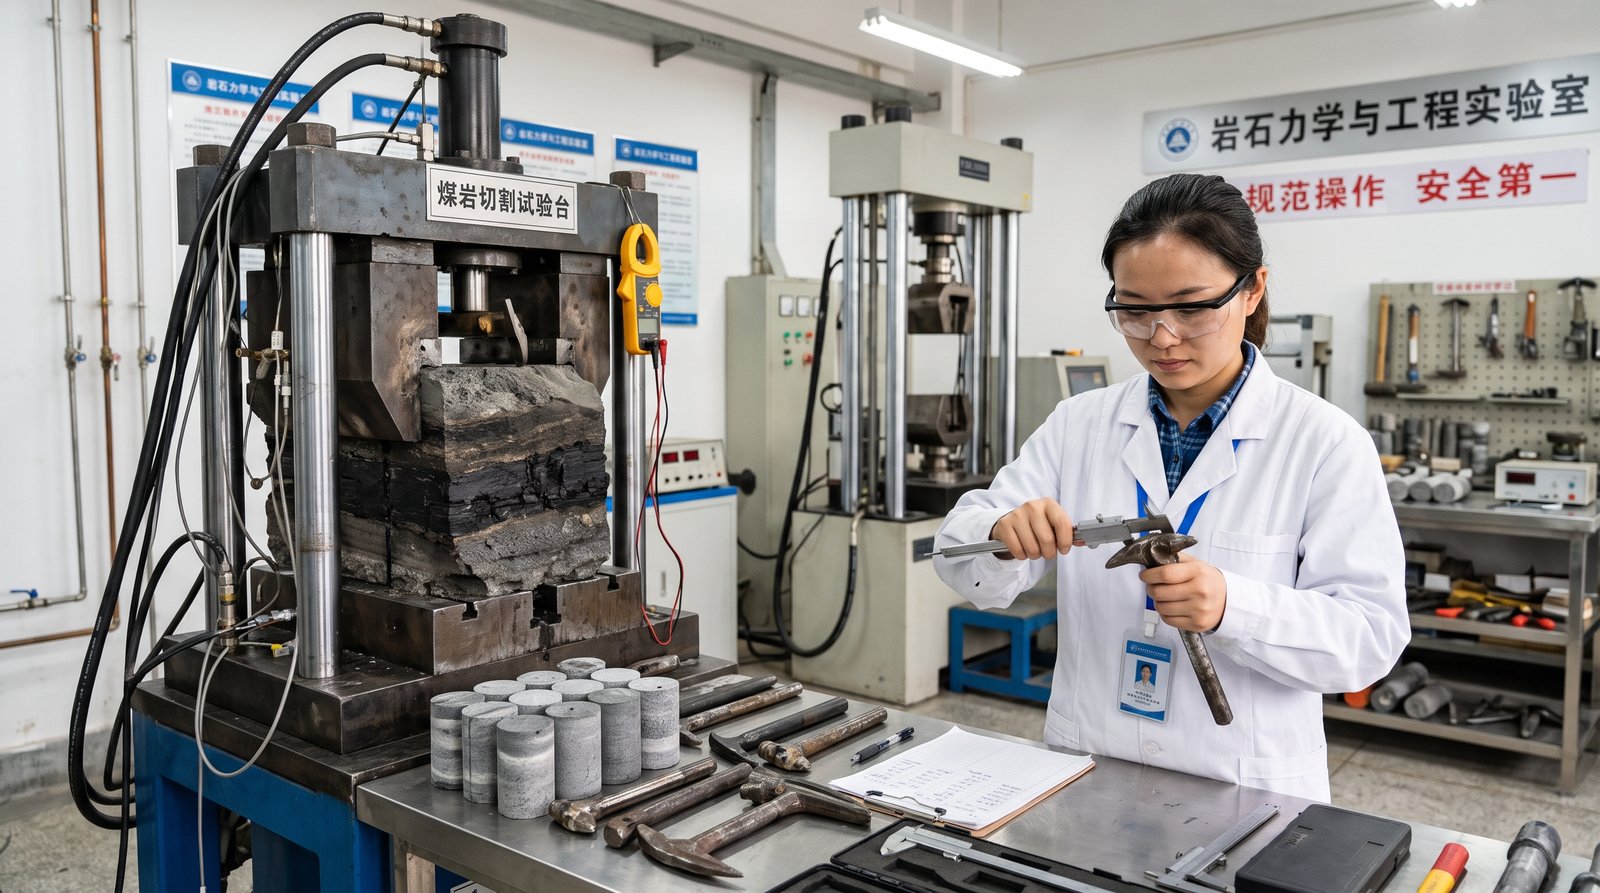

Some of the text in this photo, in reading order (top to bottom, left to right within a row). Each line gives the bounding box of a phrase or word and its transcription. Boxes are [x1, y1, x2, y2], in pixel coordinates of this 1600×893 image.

[1211, 73, 1590, 152] 岩石力学与工程实验室
[437, 180, 570, 220] 煤岩切割试验台
[1247, 162, 1577, 214] 规范操作 安全第一
